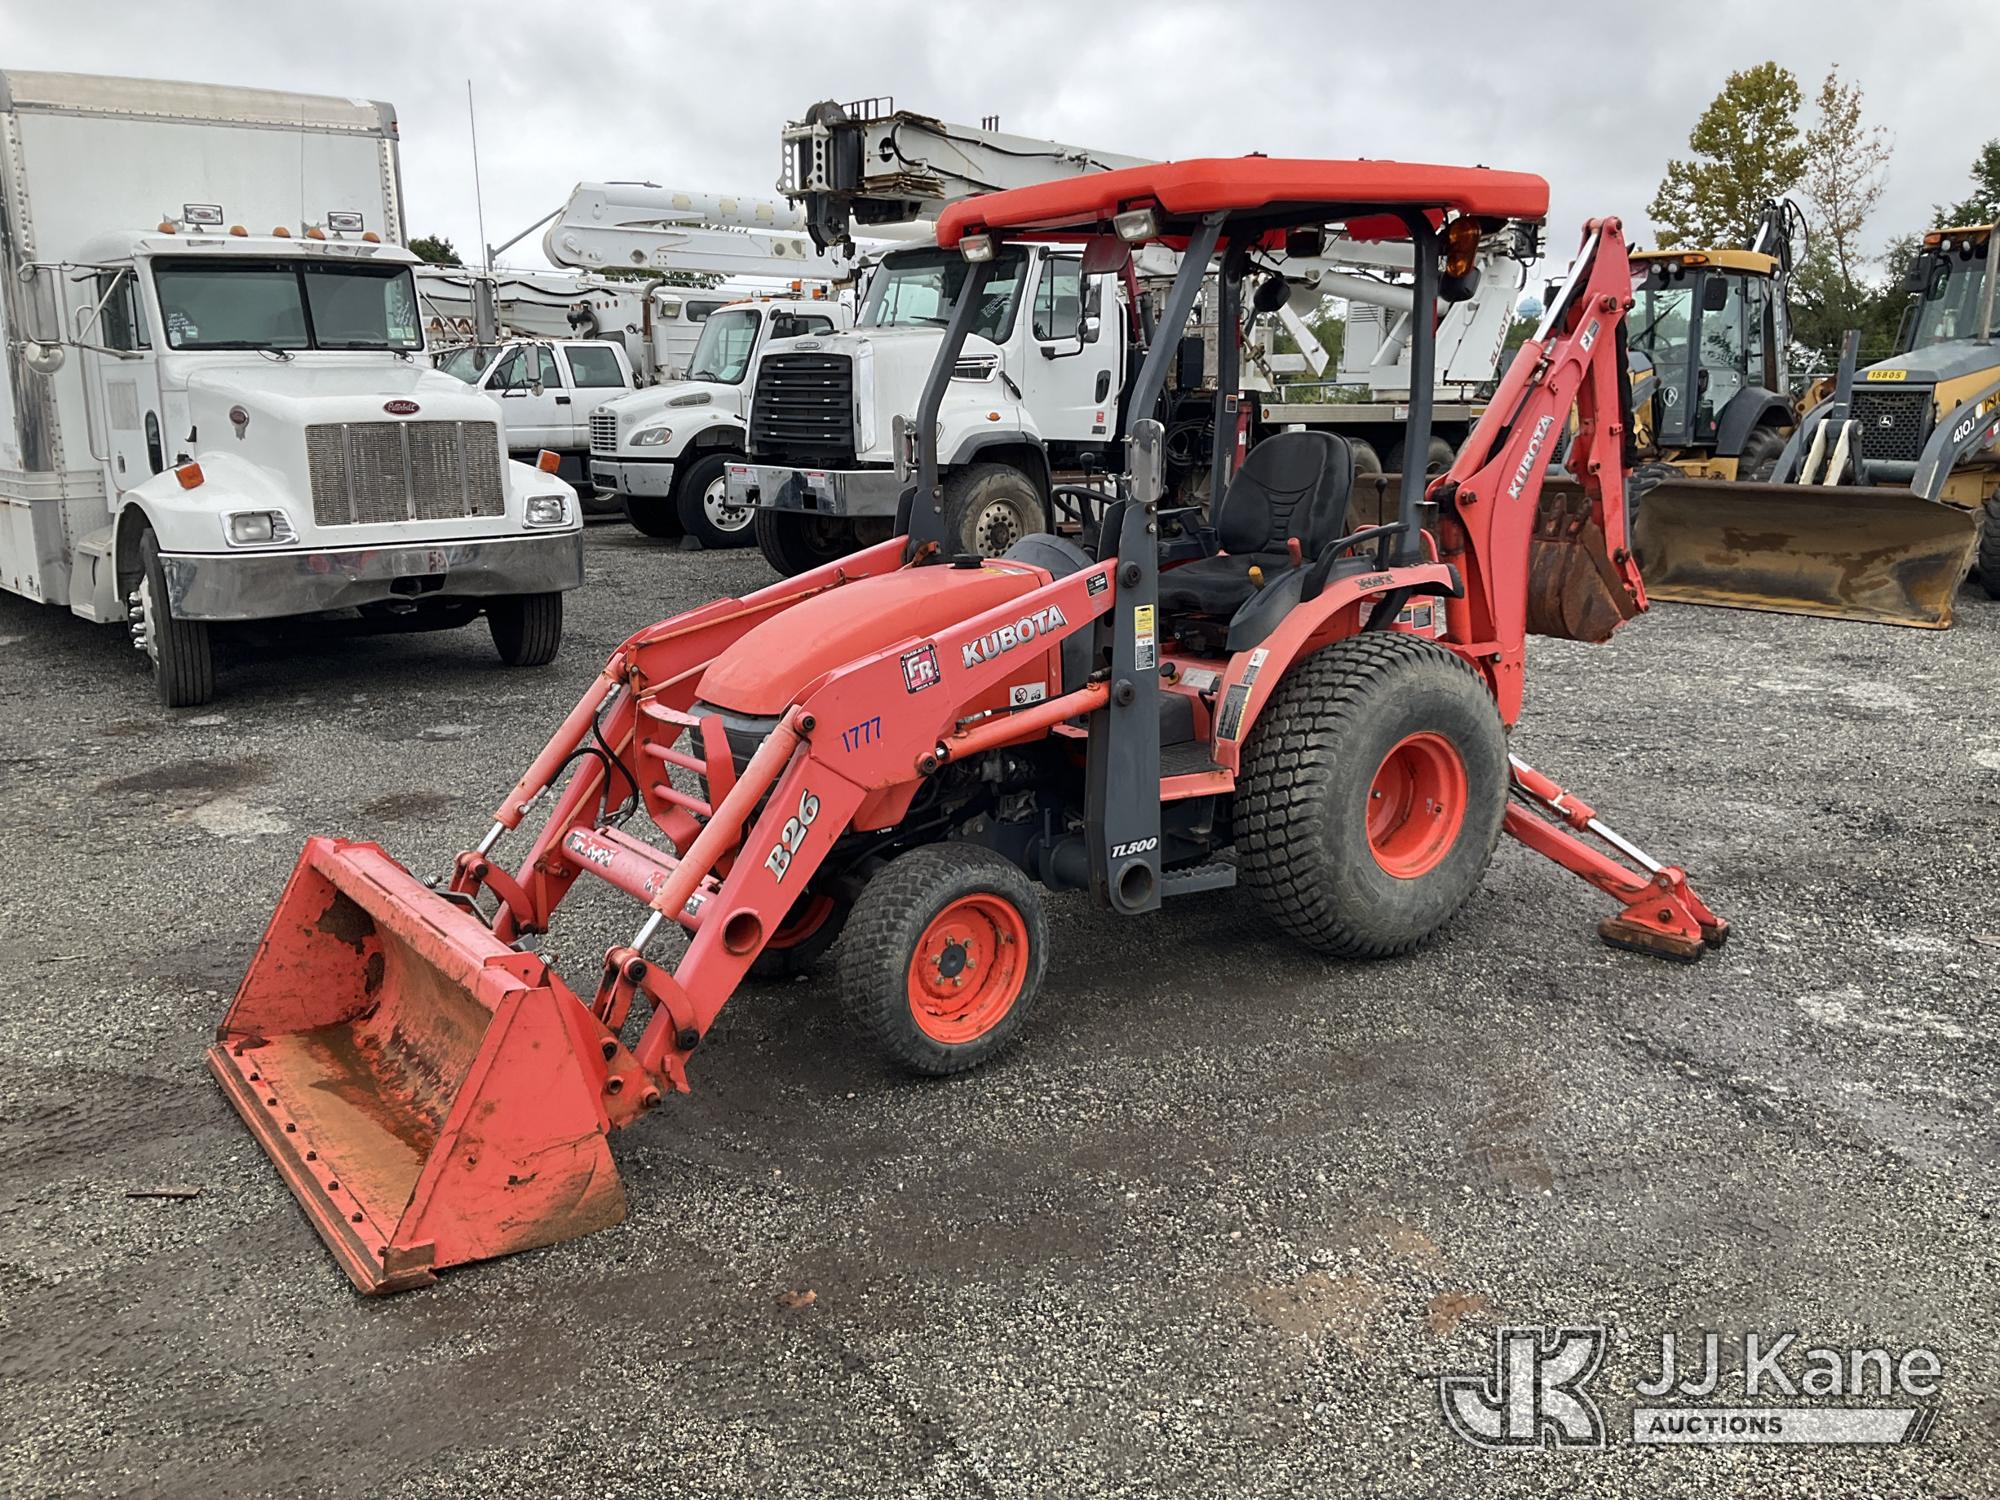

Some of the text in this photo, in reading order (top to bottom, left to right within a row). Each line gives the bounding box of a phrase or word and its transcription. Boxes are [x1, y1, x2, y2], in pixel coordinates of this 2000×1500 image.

[1489, 303, 1511, 366] ELLIOTT
[1871, 371, 1902, 379] 15805
[1953, 416, 1975, 443] 410J
[1507, 415, 1554, 501] KUBOTA
[961, 604, 1068, 670] KUBOTA
[907, 655, 934, 682] FR
[842, 715, 881, 752] 1777
[764, 788, 820, 884] B26
[1111, 836, 1158, 858] TL500
